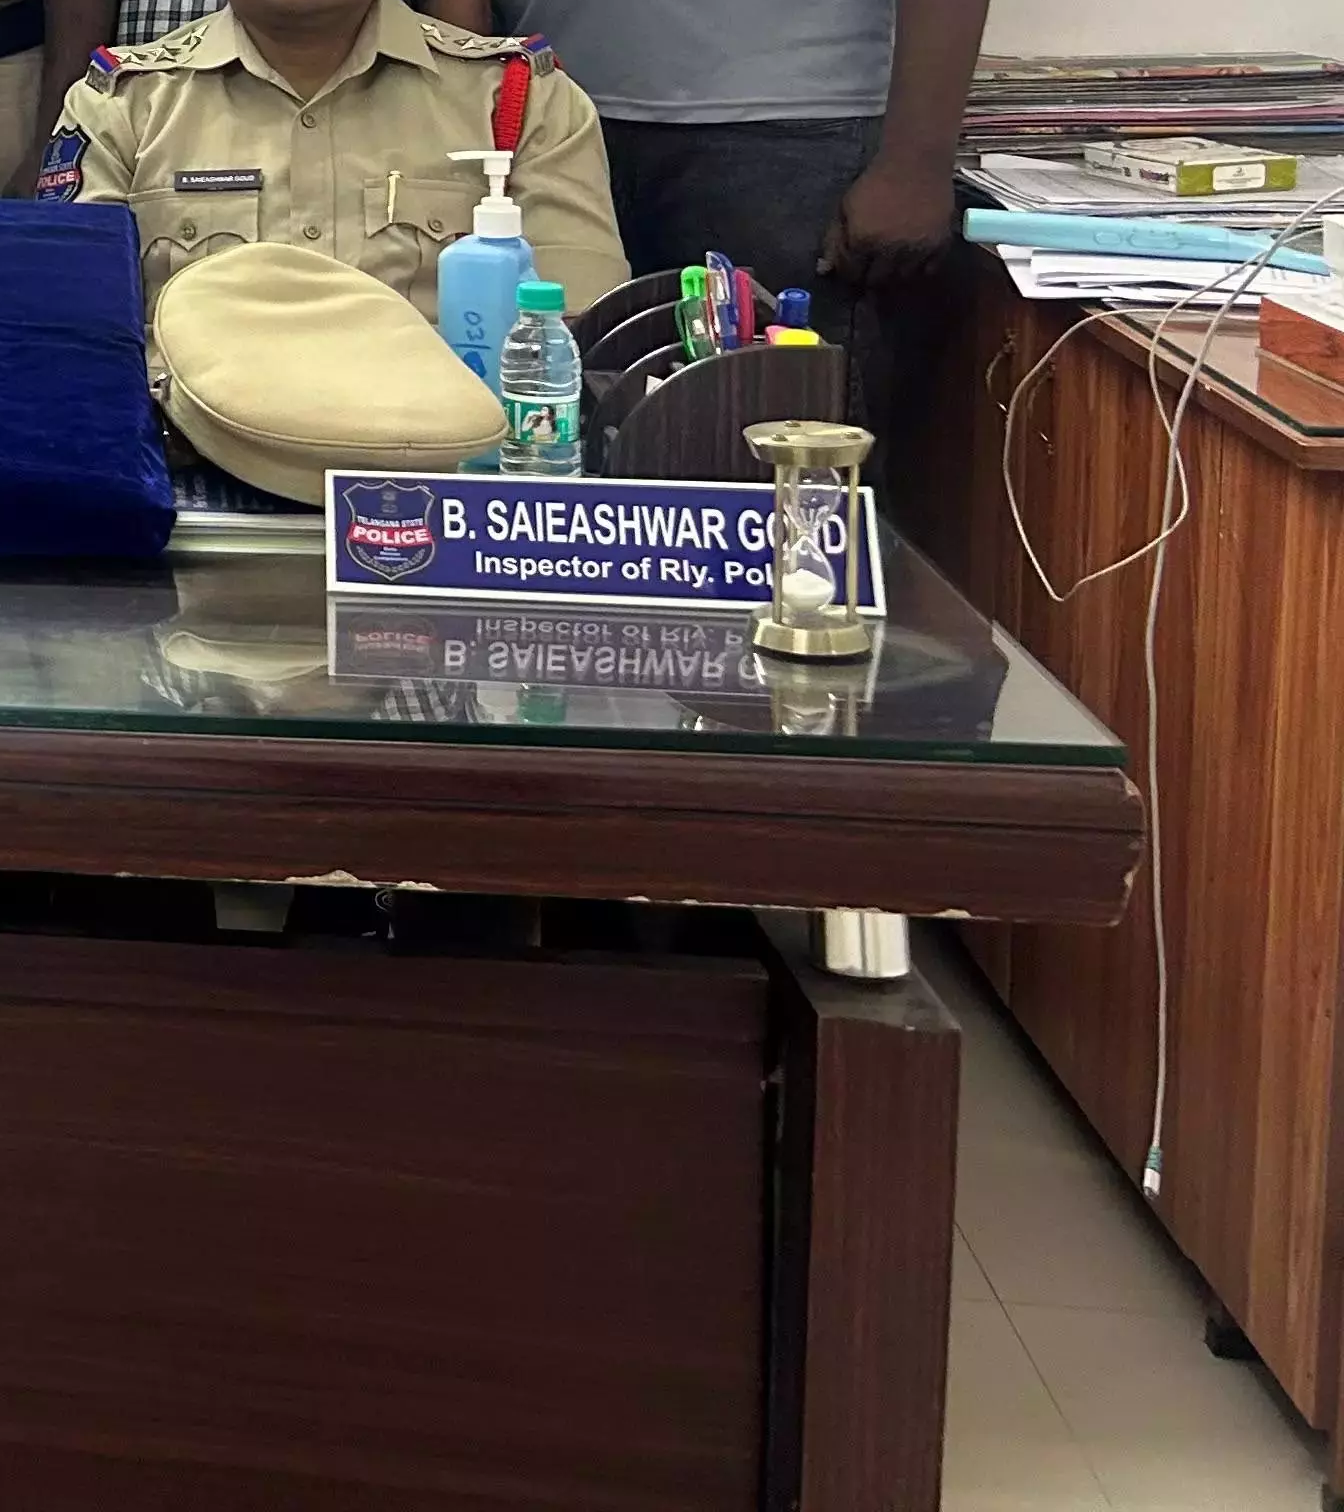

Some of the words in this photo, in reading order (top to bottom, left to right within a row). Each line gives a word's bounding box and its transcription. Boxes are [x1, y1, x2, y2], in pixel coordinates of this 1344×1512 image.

[353, 525, 430, 545] POLICE
[442, 498, 476, 540] B.
[486, 499, 730, 551] SAIEASHWAR
[475, 550, 614, 581] Inspector
[621, 557, 652, 581] of
[661, 557, 715, 589] Rly.
